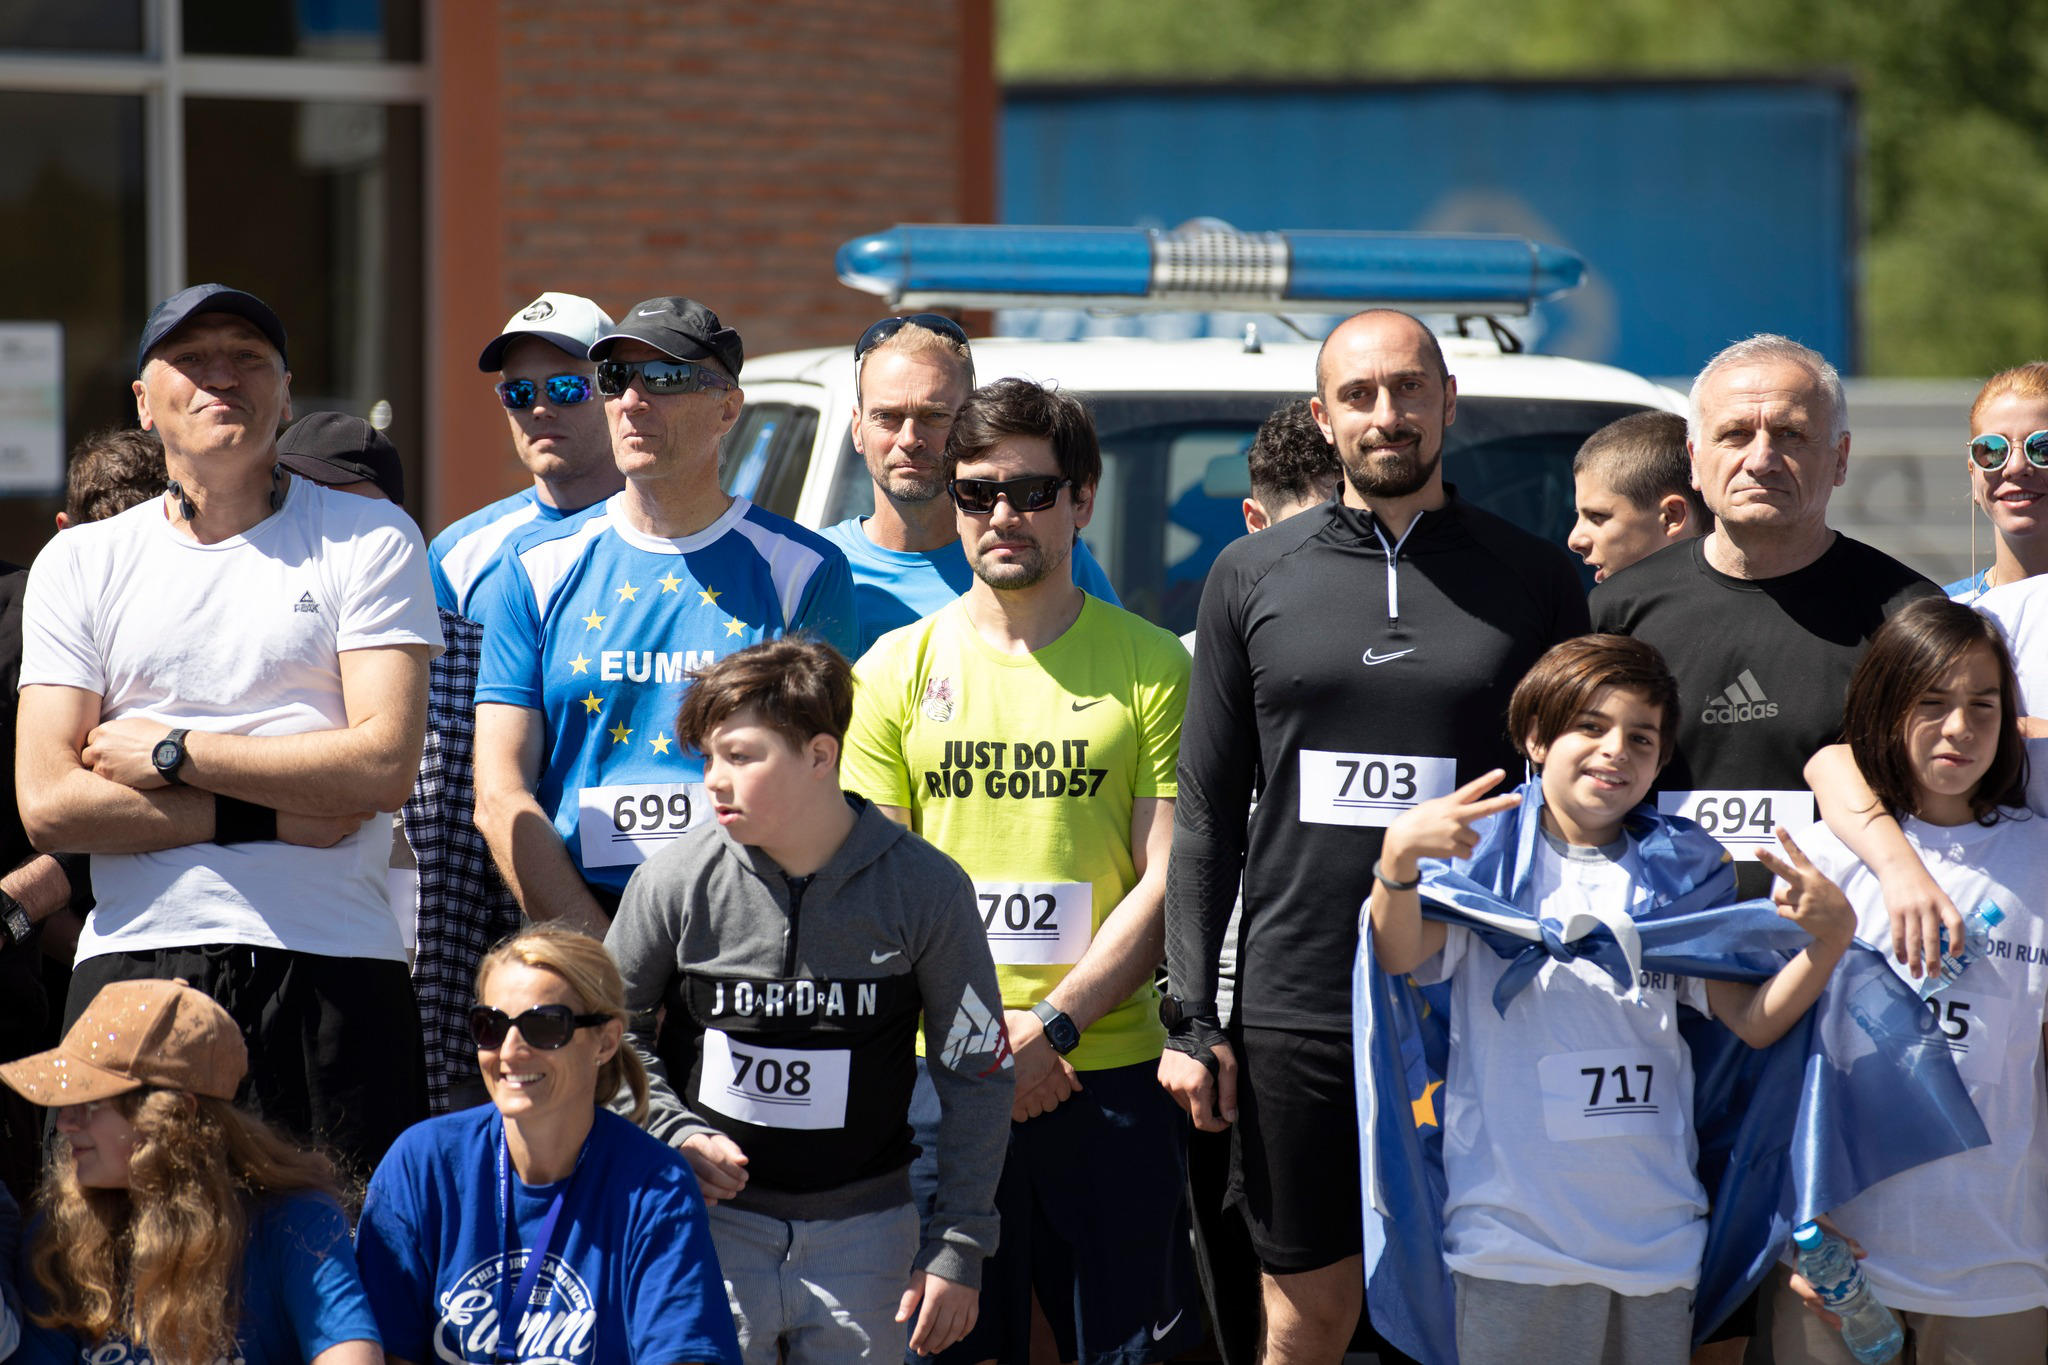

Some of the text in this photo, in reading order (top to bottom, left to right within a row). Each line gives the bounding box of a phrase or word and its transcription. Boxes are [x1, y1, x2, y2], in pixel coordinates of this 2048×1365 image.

[600, 650, 715, 684] EUMM
[1701, 702, 1779, 724] adidas
[940, 739, 1089, 770] JUST DO IT
[925, 770, 974, 799] RIO
[1336, 760, 1417, 800] 703
[613, 793, 692, 832] 699
[1695, 797, 1775, 834] 694
[978, 893, 1058, 931] 702
[1985, 939, 2012, 959] ORI
[711, 980, 877, 1017] JORDAN
[1639, 971, 1667, 990] ORI
[1914, 996, 1971, 1041] 05
[731, 1051, 811, 1096] 708
[1581, 1065, 1654, 1106] 717
[467, 1265, 495, 1289] THE
